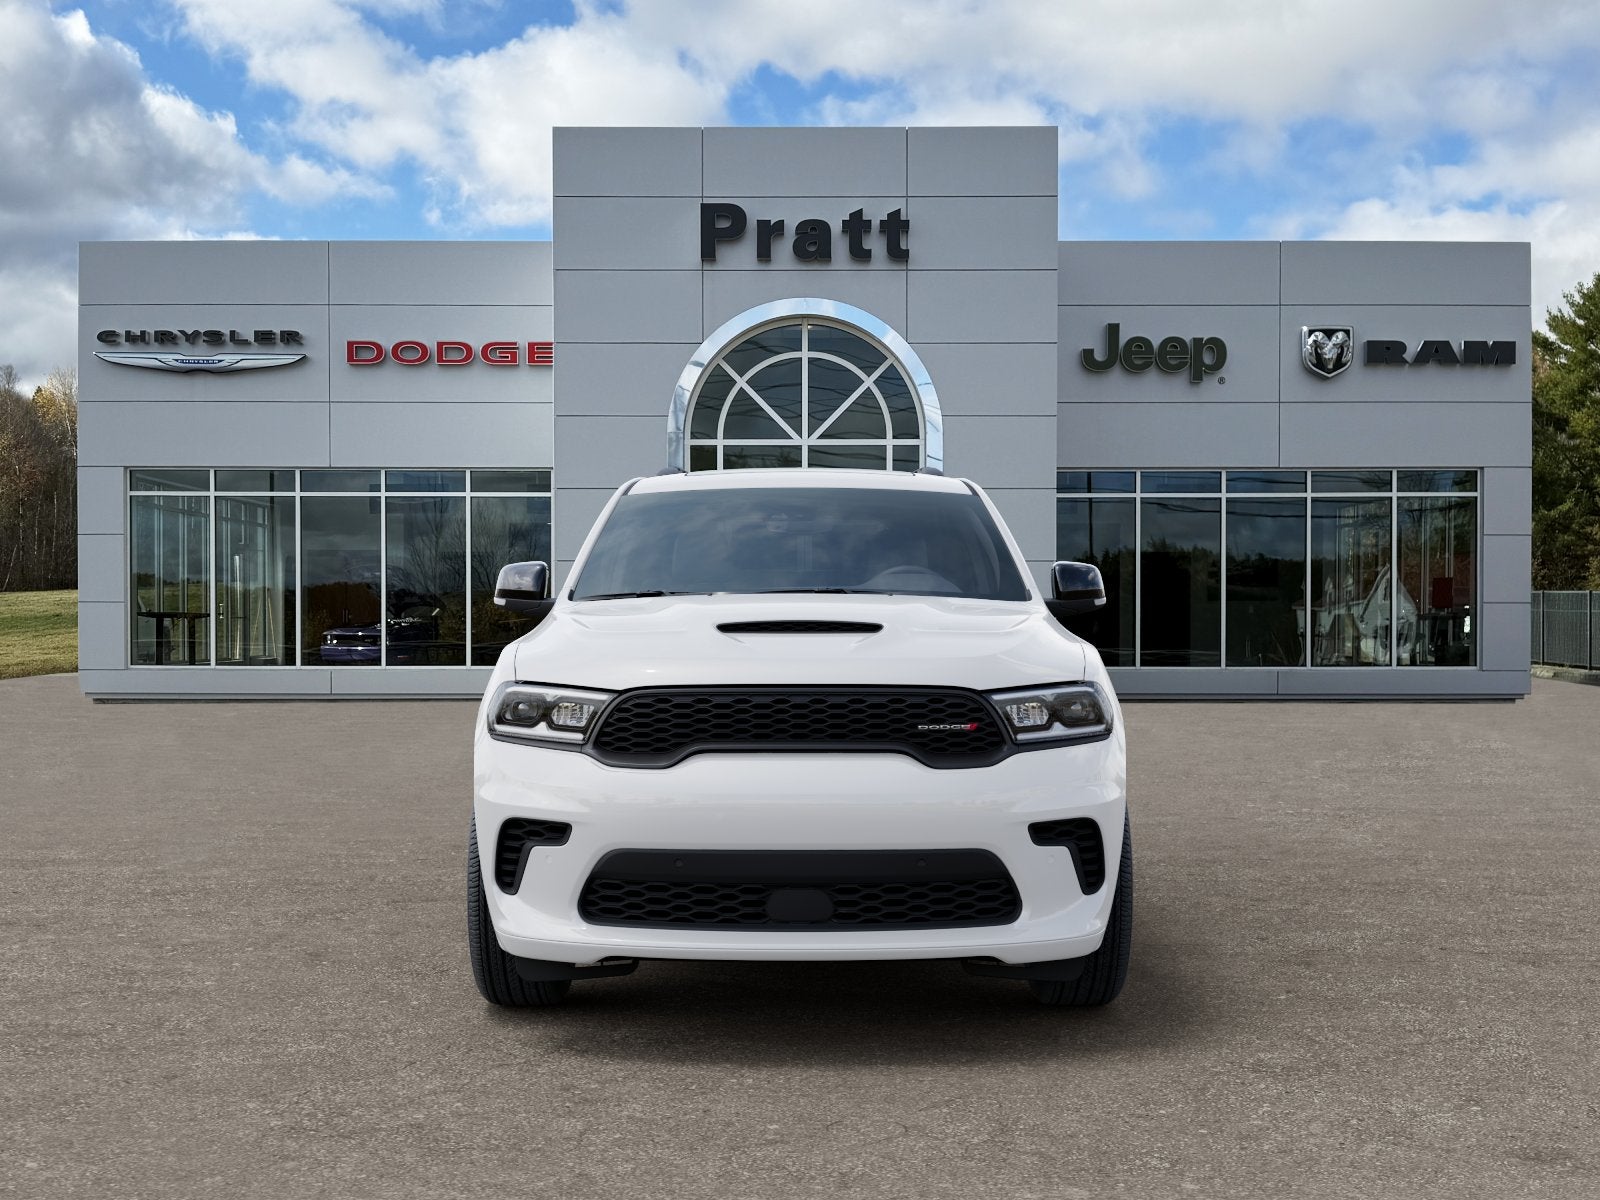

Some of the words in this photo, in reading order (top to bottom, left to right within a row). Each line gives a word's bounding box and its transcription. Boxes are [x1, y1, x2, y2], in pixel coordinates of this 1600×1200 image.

[700, 203, 910, 261] Pratt
[97, 329, 303, 345] CHRYSLER
[346, 340, 554, 366] DODGE
[1081, 322, 1228, 384] Jeep
[1364, 340, 1517, 365] RAM
